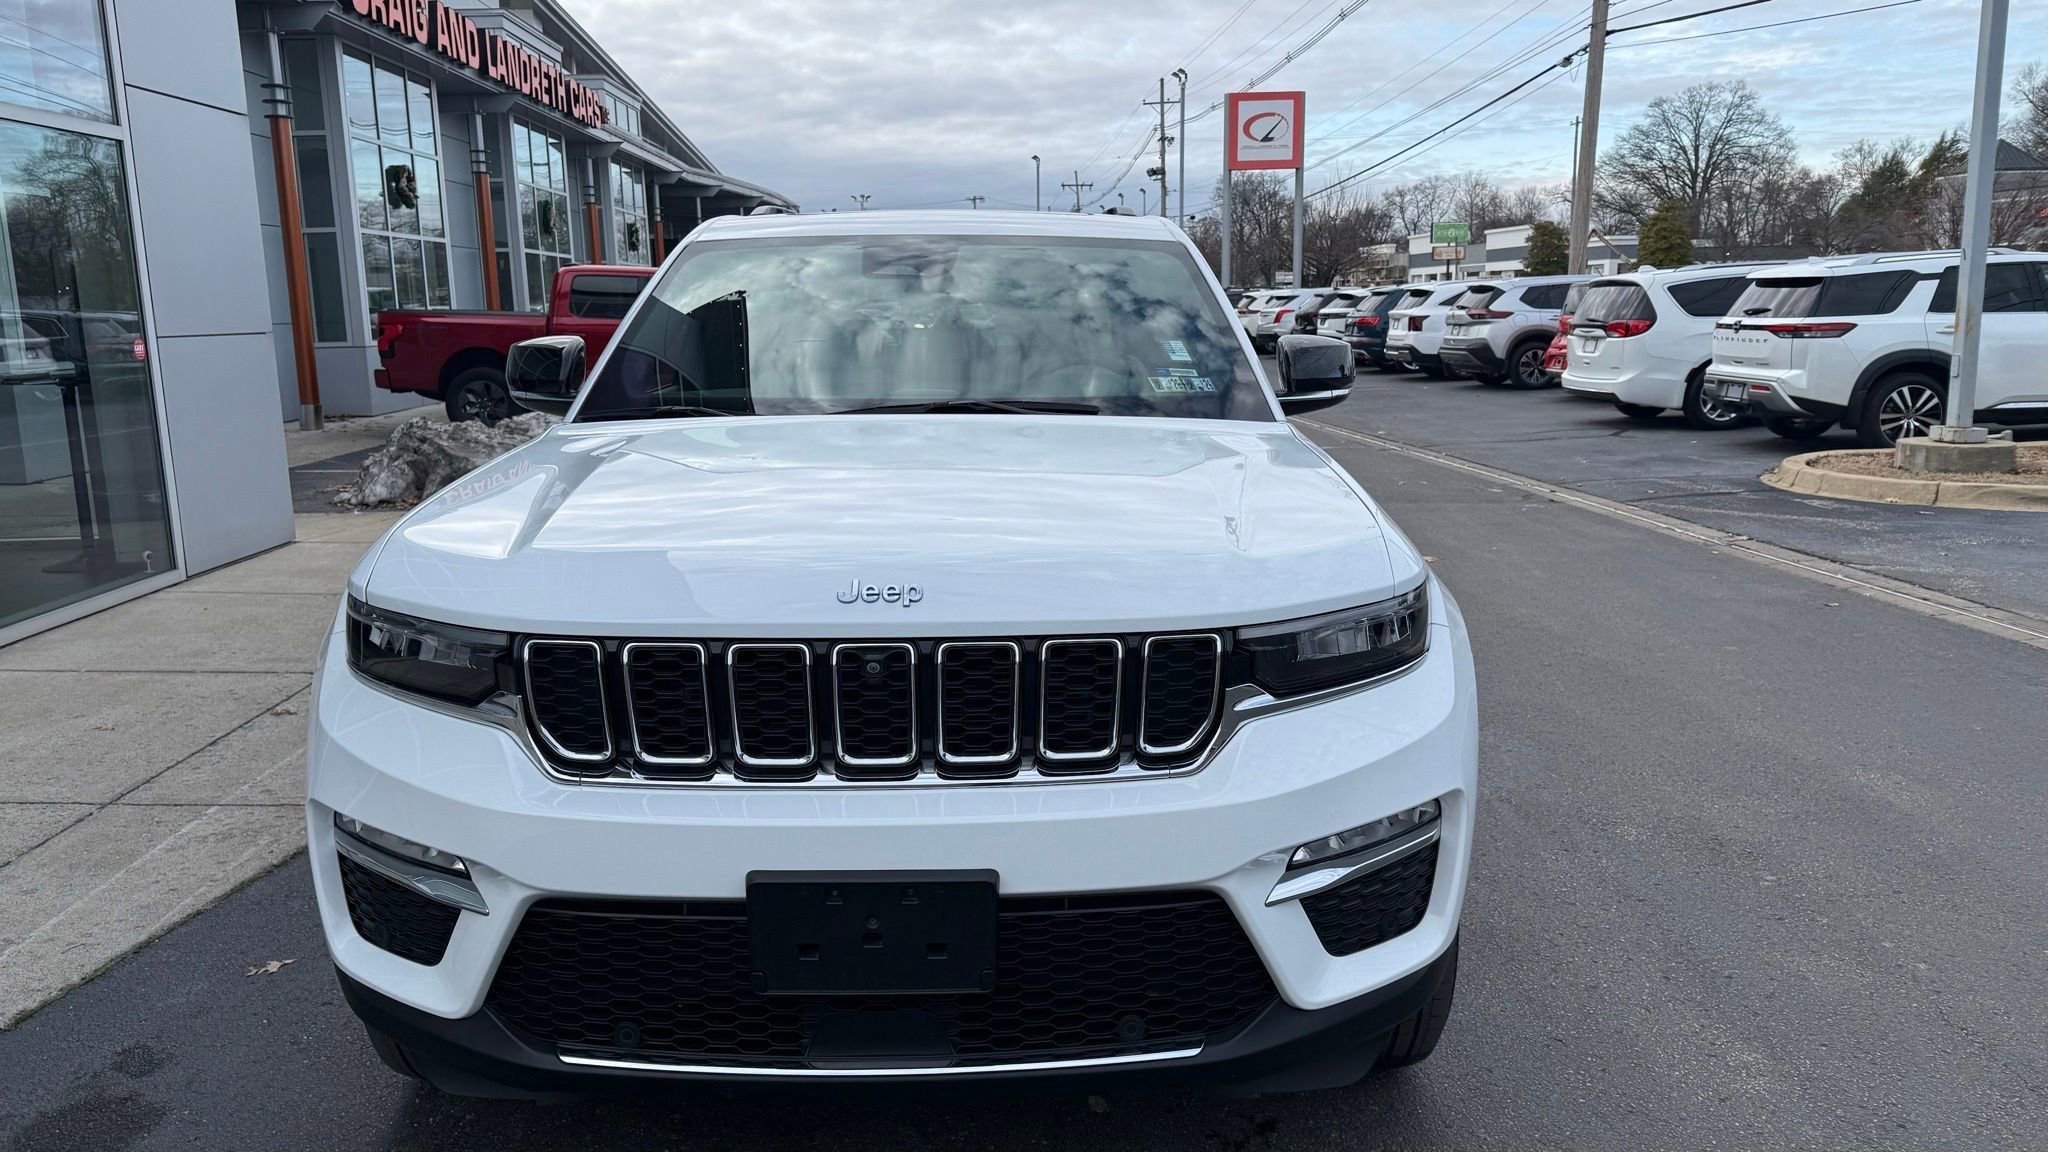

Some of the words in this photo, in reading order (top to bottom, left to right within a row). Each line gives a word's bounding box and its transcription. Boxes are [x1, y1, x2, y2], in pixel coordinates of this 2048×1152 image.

[352, 0, 428, 45] AIG
[437, 1, 480, 70] AND
[485, 29, 568, 113] LANDRETH
[570, 78, 602, 129] CARS
[836, 578, 924, 608] Jeep
